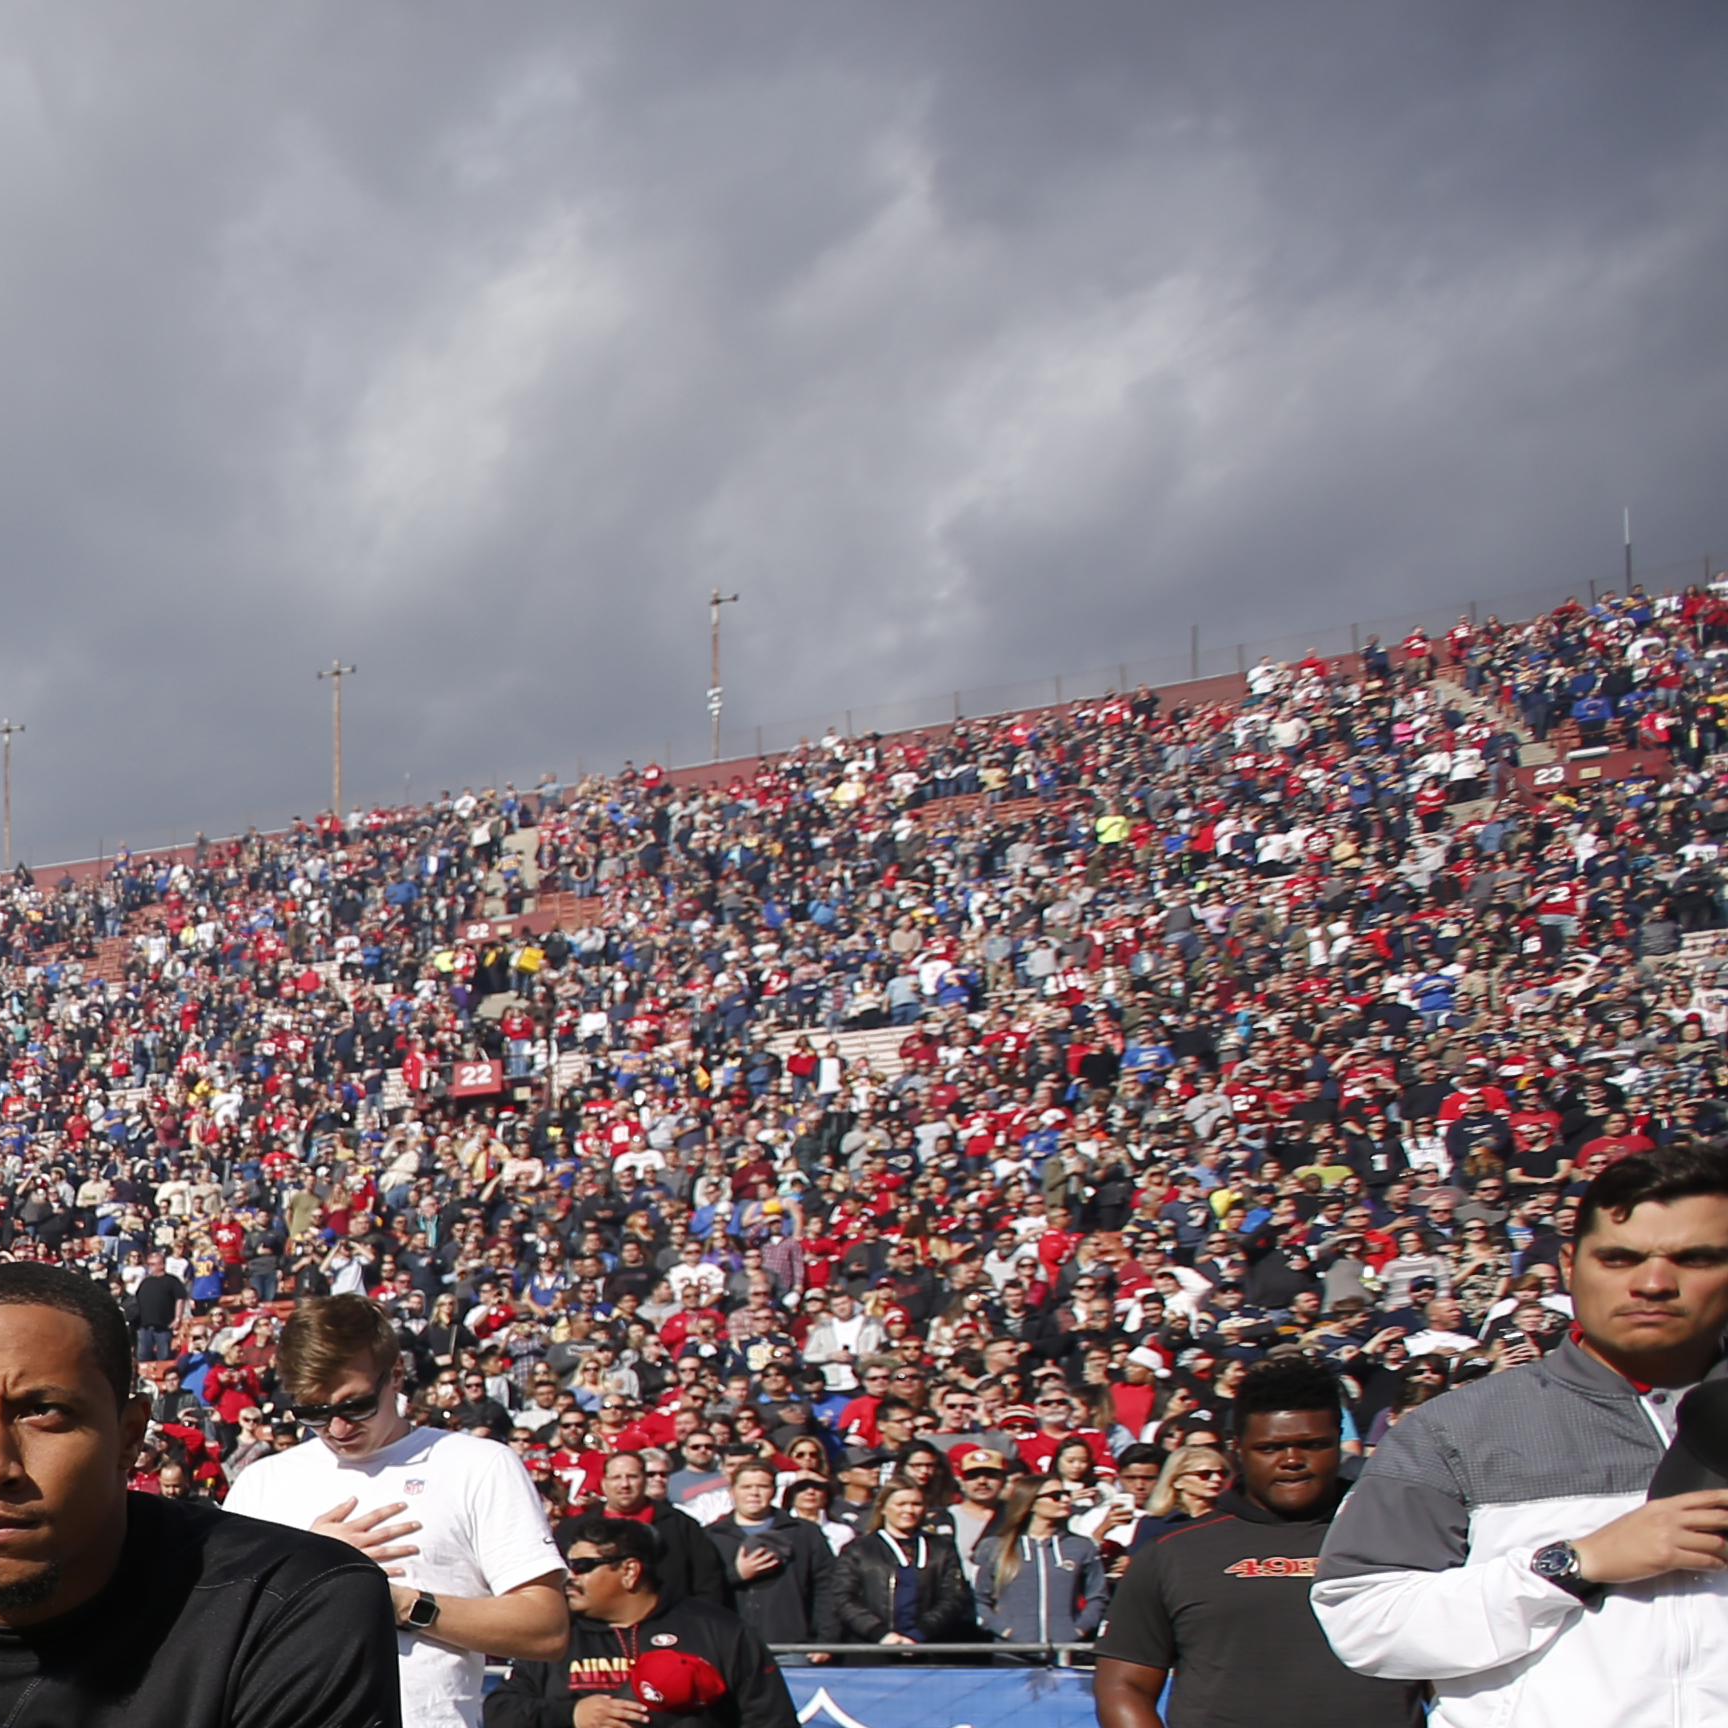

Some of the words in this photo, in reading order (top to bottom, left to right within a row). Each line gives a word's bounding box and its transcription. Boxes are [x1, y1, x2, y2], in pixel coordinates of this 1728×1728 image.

[1534, 766, 1565, 786] 23
[467, 922, 490, 940] 22
[460, 1064, 493, 1087] 22
